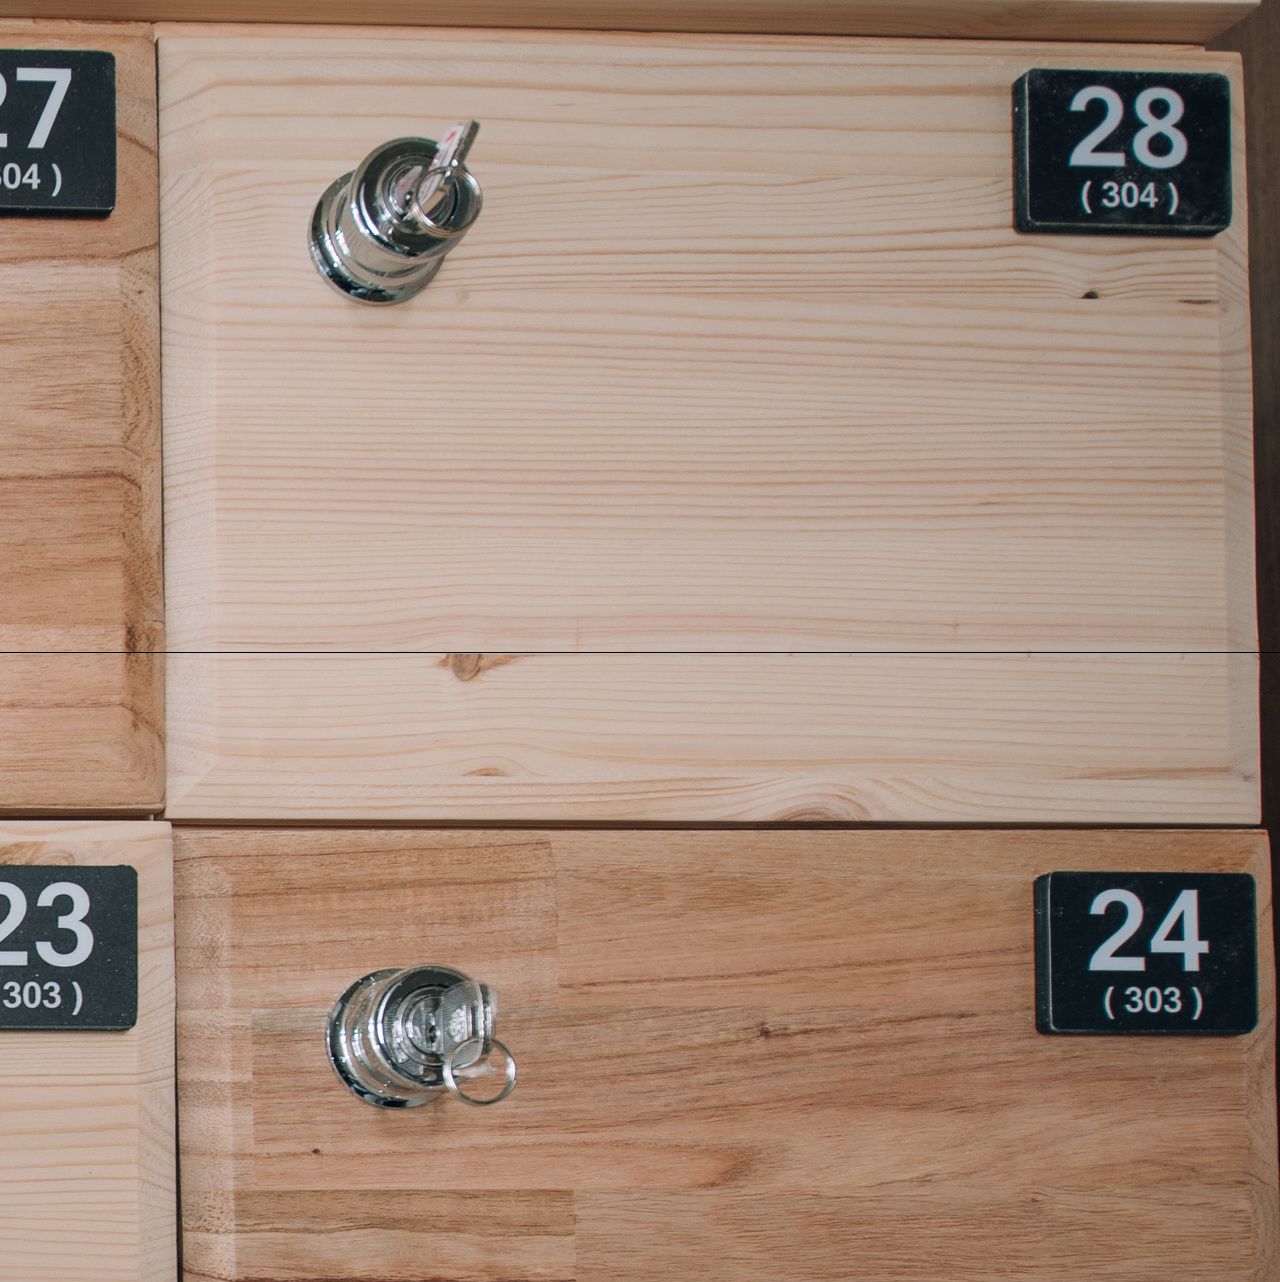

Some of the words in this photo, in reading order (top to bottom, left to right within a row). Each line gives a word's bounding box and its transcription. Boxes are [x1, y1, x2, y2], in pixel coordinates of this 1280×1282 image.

[1069, 86, 1188, 168] 28
[1081, 181, 1179, 215] (304)
[1088, 888, 1210, 972] 24
[1103, 985, 1203, 1020] (303)
